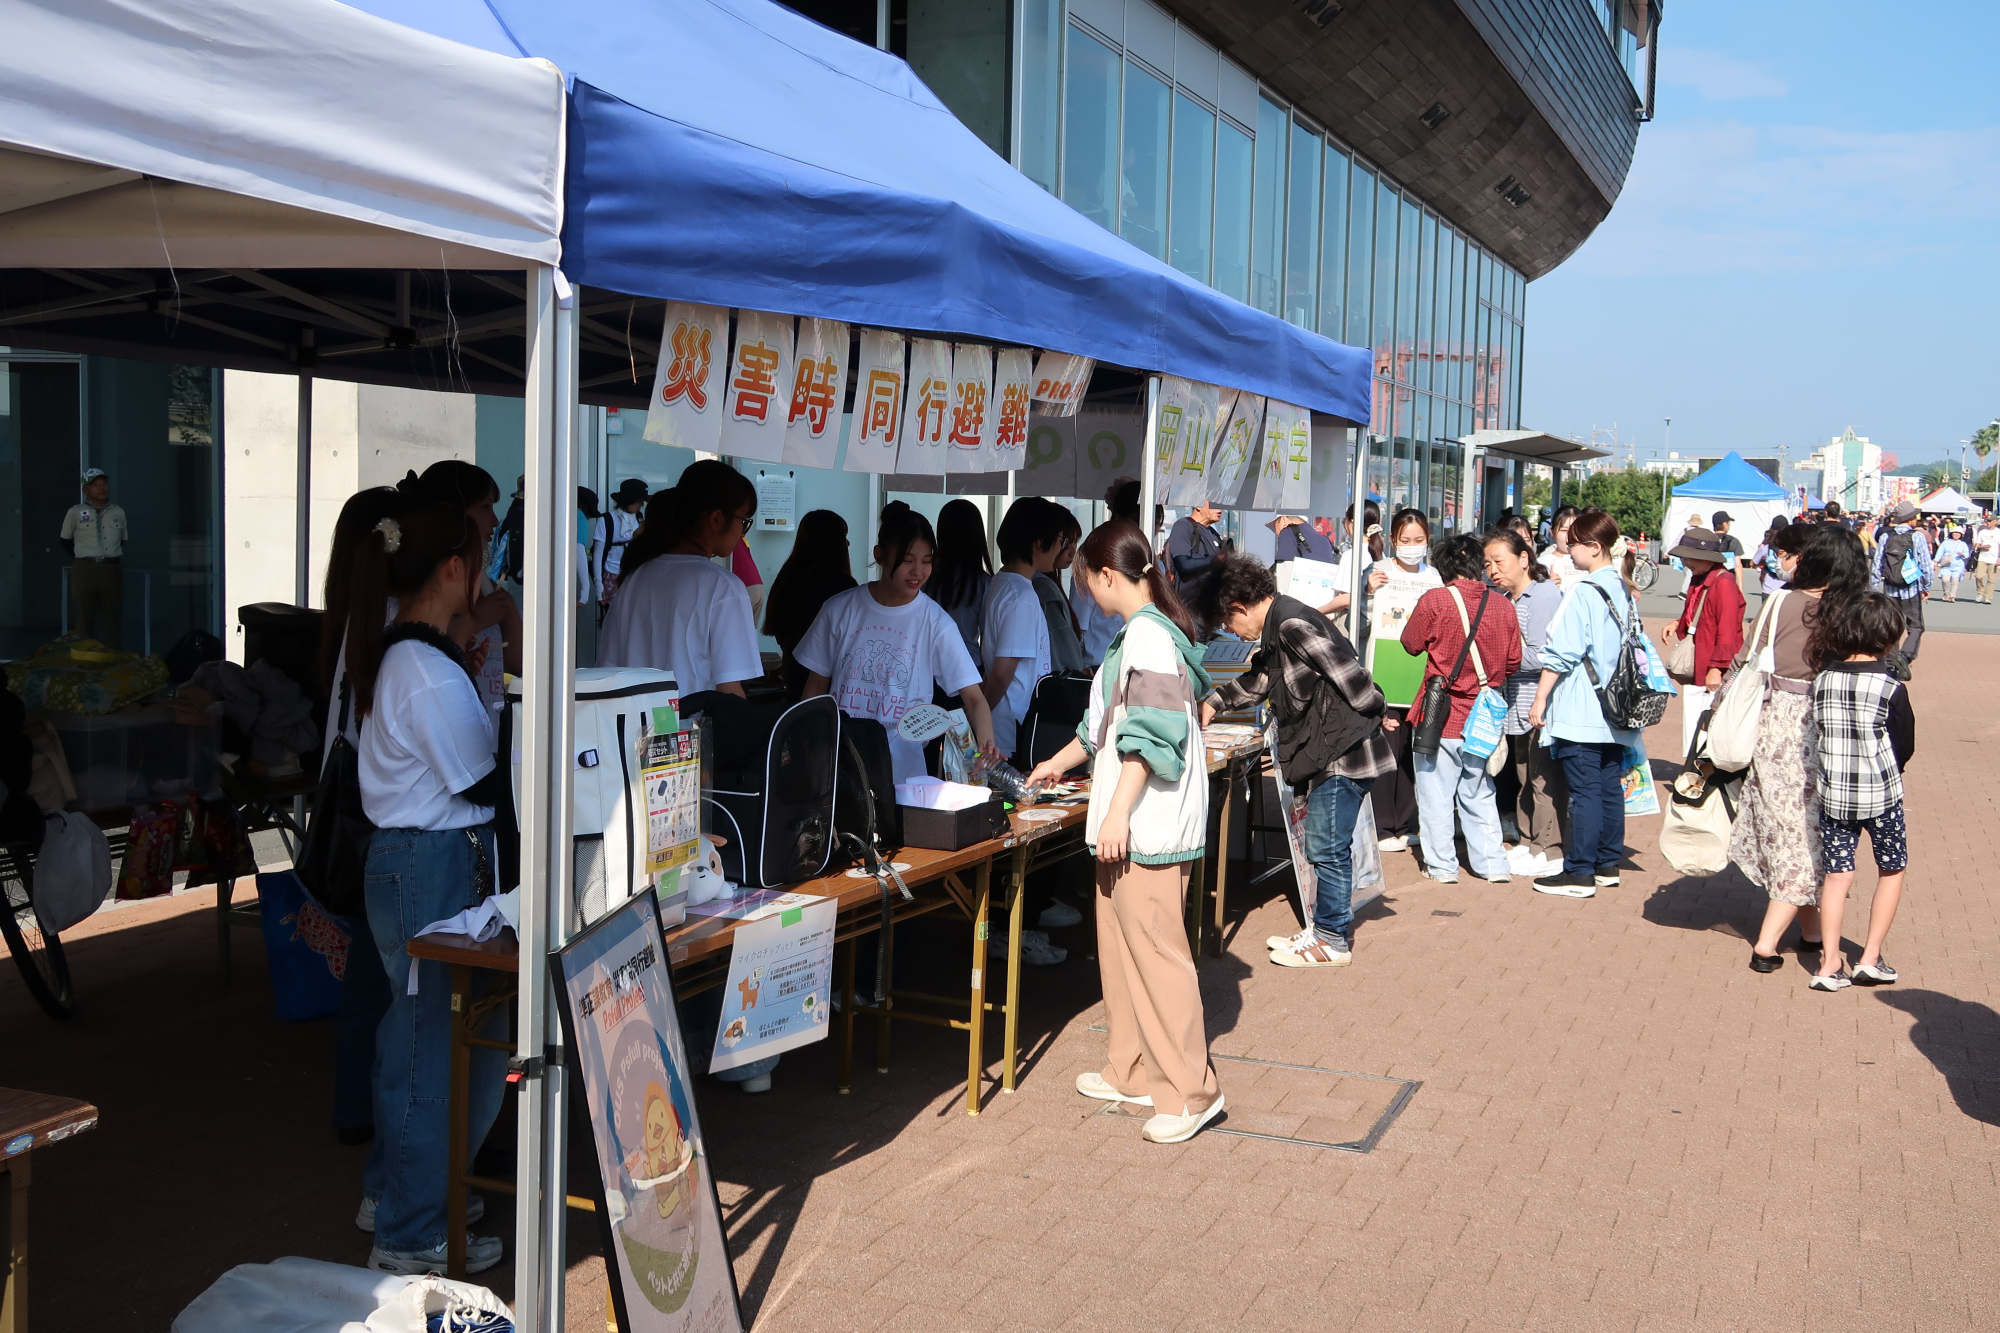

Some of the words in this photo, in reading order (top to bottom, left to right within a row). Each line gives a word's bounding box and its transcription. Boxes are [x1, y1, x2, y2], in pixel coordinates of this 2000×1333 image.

[662, 320, 1029, 448] 災害時同行避難
[1035, 378, 1084, 400] PRO
[1157, 404, 1308, 480] 岡山科大学
[840, 684, 888, 701] QUALITY
[890, 695, 906, 704] OF
[866, 698, 911, 719] LIVE
